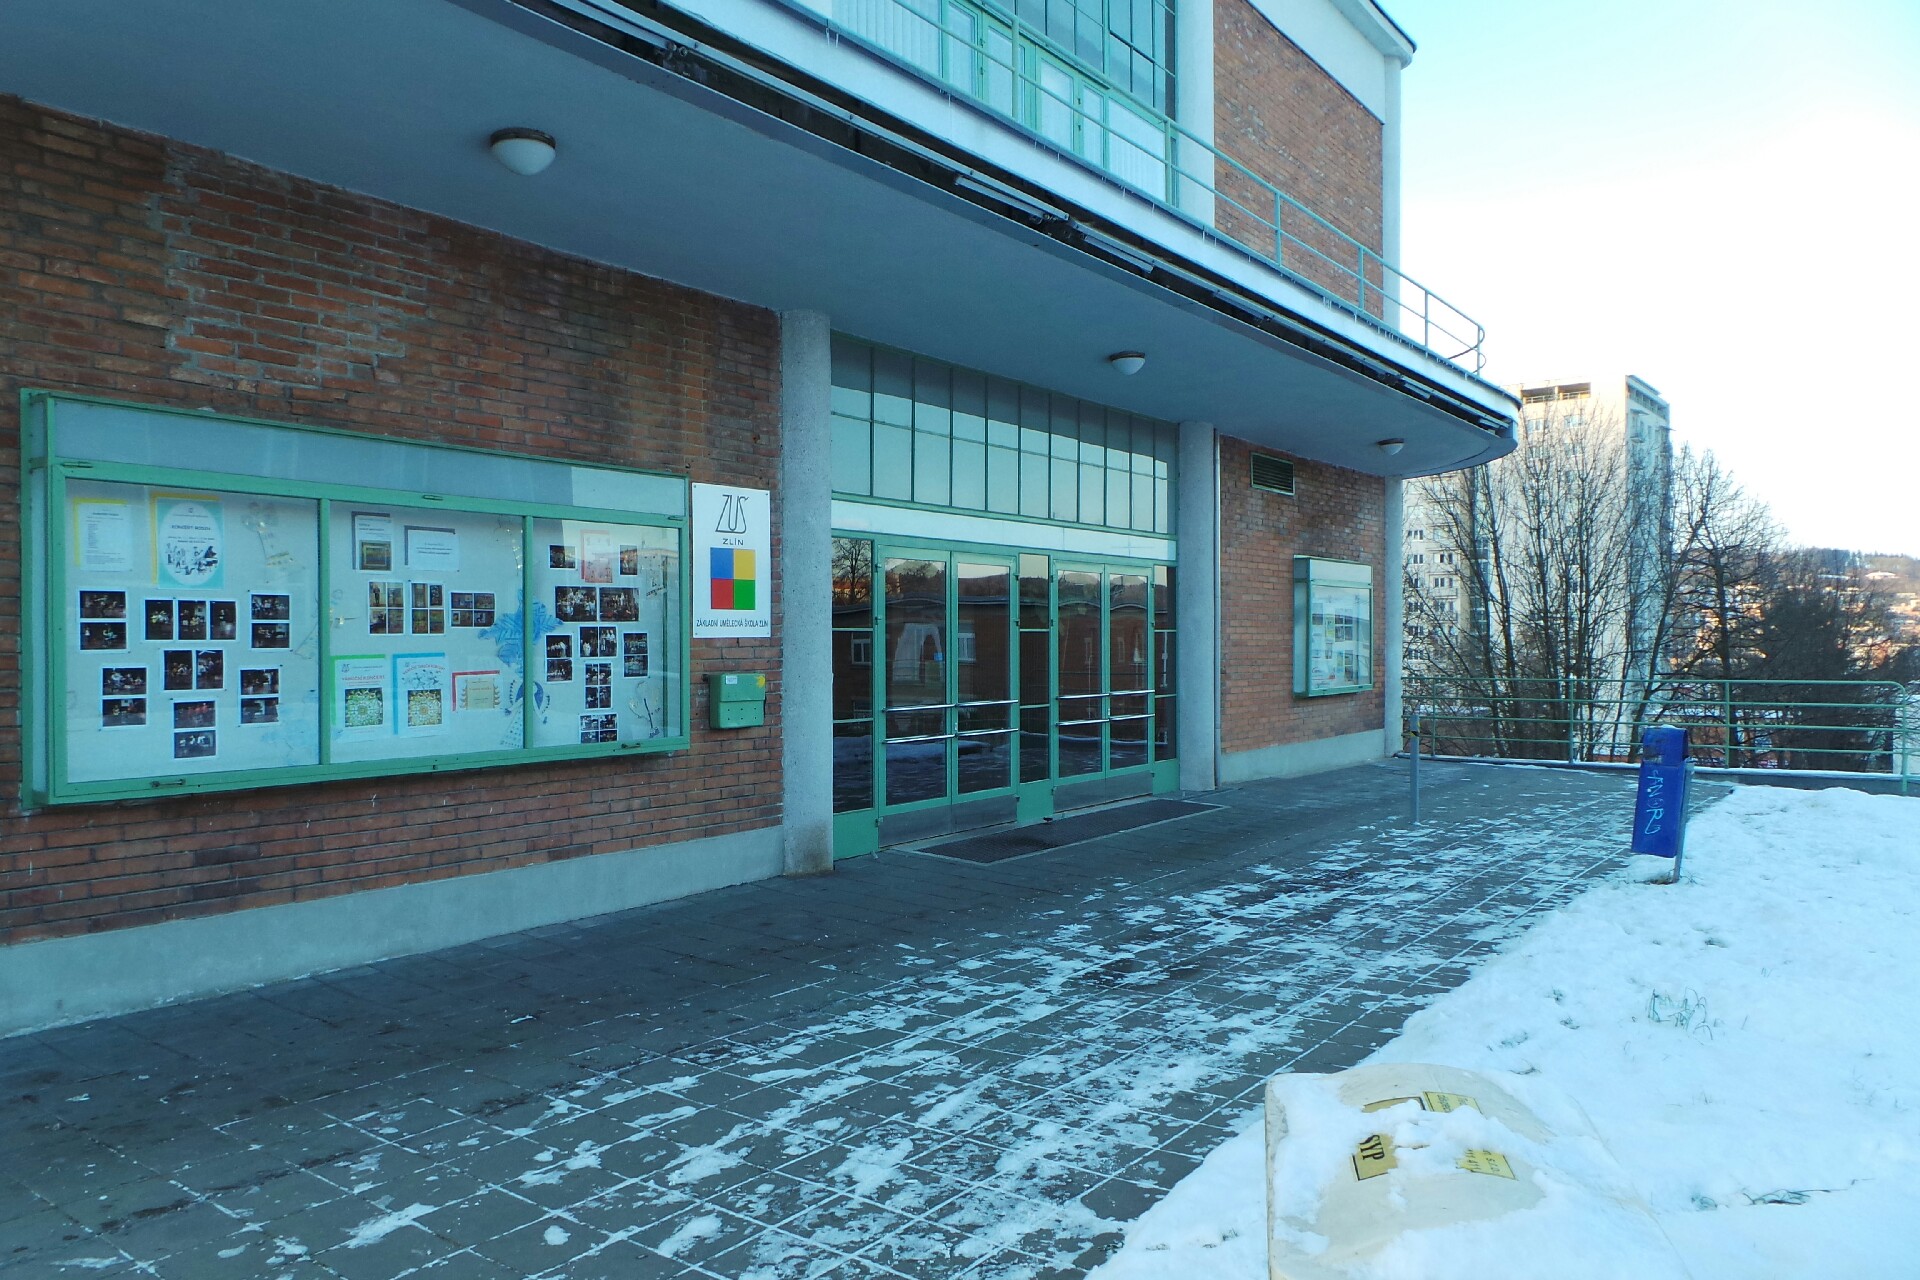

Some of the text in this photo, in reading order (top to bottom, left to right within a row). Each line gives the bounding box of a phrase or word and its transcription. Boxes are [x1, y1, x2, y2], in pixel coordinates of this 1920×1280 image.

[722, 537, 744, 546] ZLÍN
[696, 617, 719, 628] ZÁKLADNÍ
[720, 617, 744, 628] UMĚLECKÁ
[744, 618, 759, 628] ŠKOLA
